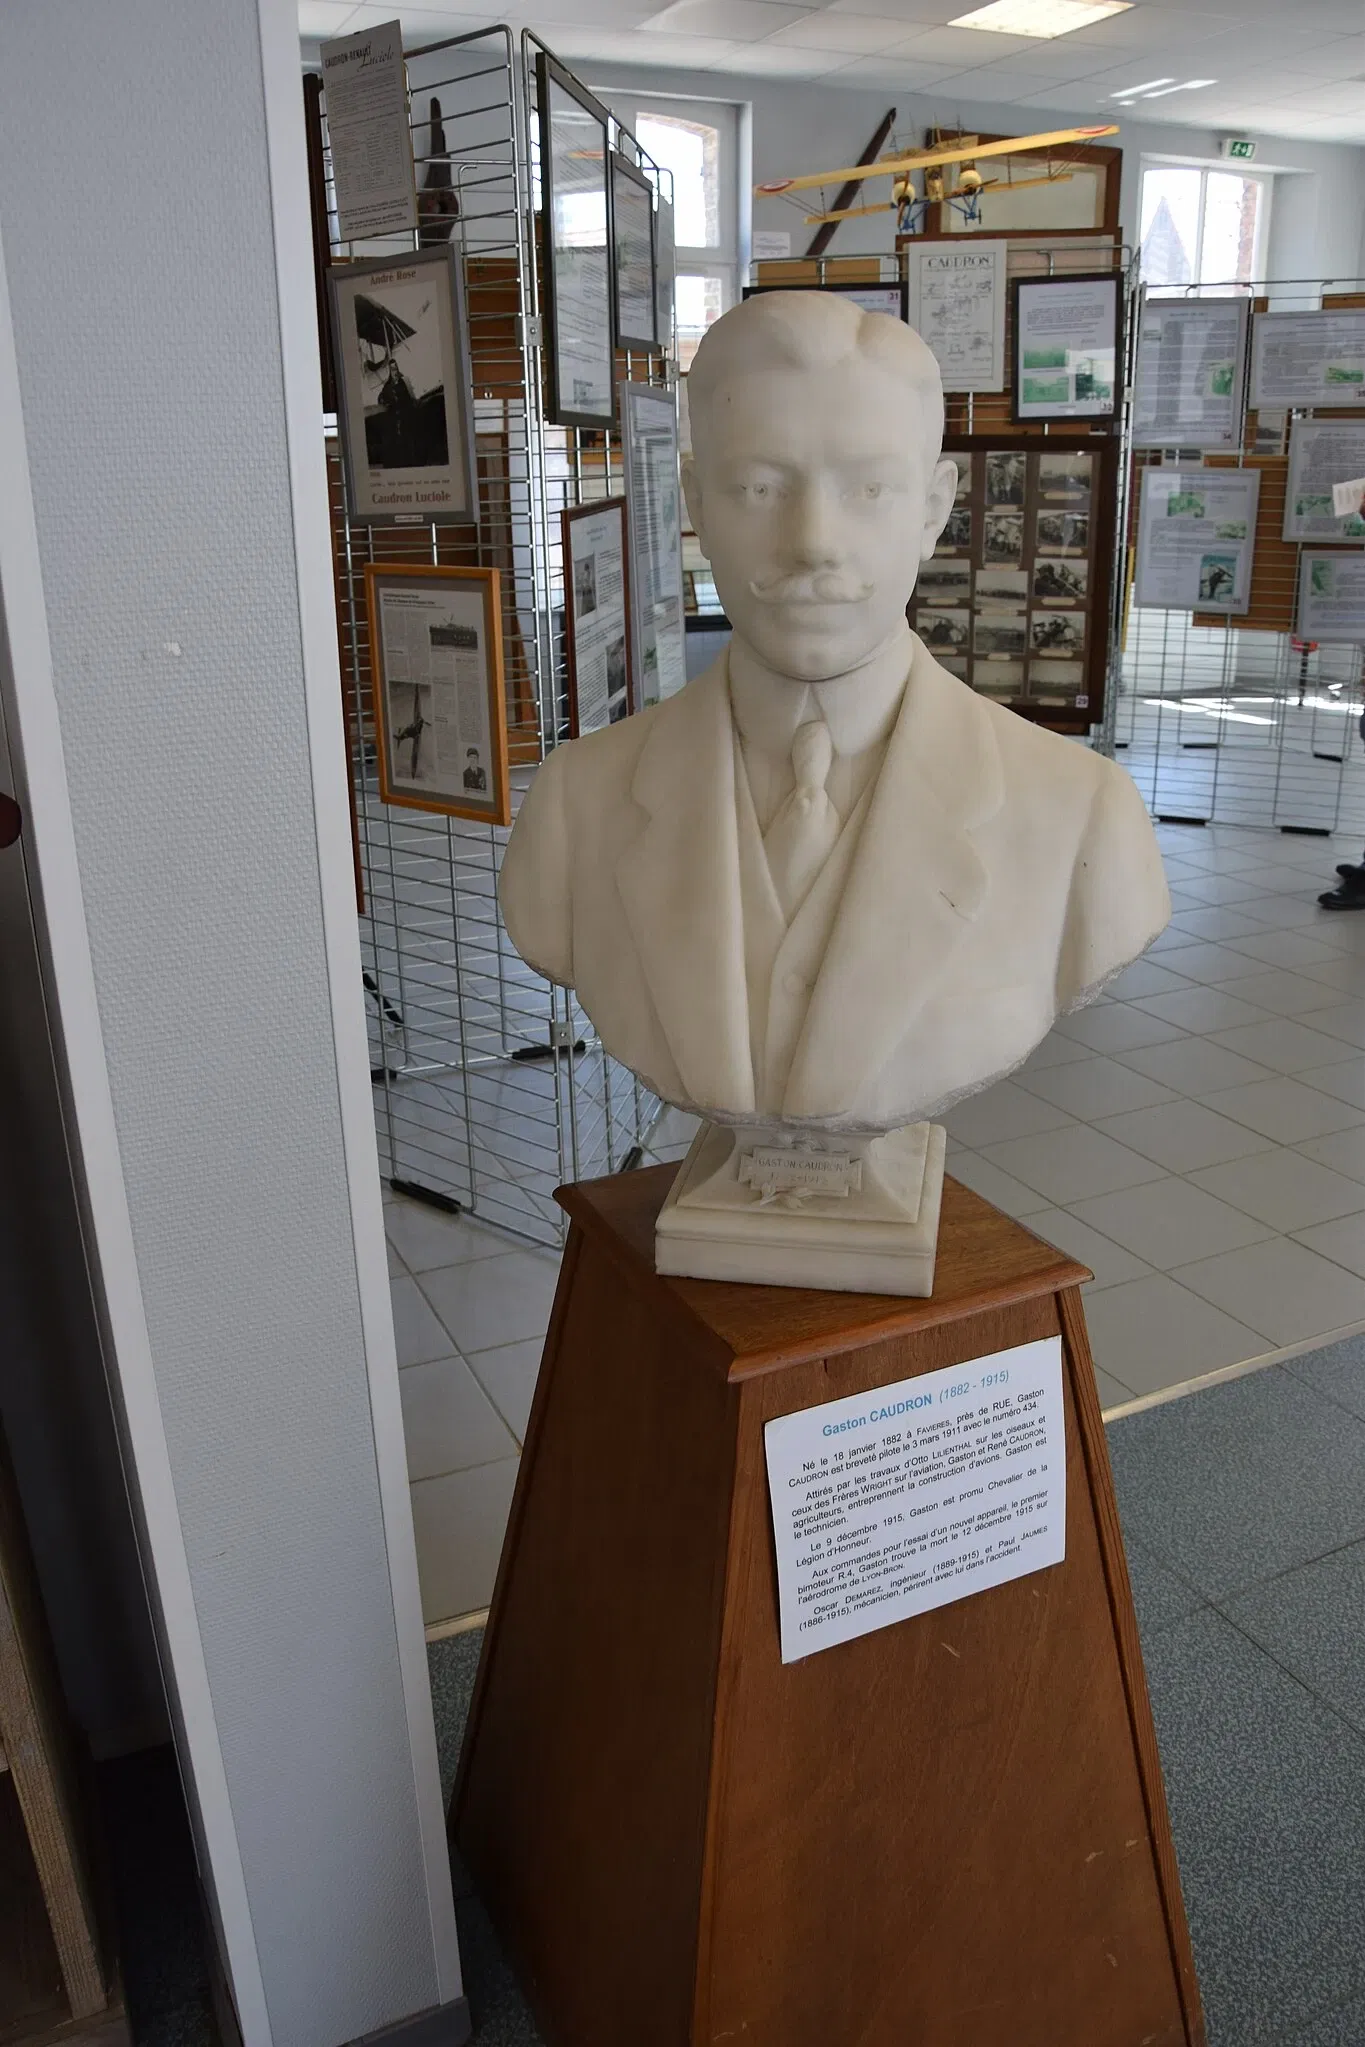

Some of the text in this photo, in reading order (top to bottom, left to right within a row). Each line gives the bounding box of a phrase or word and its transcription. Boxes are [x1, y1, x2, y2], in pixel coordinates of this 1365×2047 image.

[370, 269, 417, 286] André Rose
[928, 256, 990, 269] CAUDRON
[371, 490, 451, 505] Caudron Luciole
[802, 1460, 816, 1472] Né
[820, 1457, 829, 1467] le
[833, 1451, 845, 1462] 18
[848, 1442, 877, 1460] janvier
[881, 1433, 902, 1447] 1882
[906, 1430, 913, 1439] à
[956, 1411, 975, 1425] près
[977, 1406, 989, 1417] de
[1017, 1388, 1045, 1403] Gaston
[822, 1416, 867, 1437] Gaston
[869, 1393, 932, 1423] CAUDRON
[939, 1381, 970, 1404] (1882
[980, 1370, 1009, 1388] 1915)
[788, 1469, 829, 1488] CAUDRON
[830, 1463, 844, 1475] est
[845, 1452, 877, 1471] breveté
[878, 1446, 901, 1462] pilote
[902, 1443, 911, 1452] le
[919, 1434, 940, 1447] mars
[942, 1425, 961, 1439] 1911
[963, 1420, 982, 1433] avec
[983, 1417, 991, 1426] le
[992, 1407, 1022, 1423] numéro
[1022, 1401, 1040, 1412] 434.
[791, 1504, 813, 1517] ceux
[814, 1499, 830, 1510] des
[832, 1489, 859, 1504] Frères
[860, 1477, 892, 1495] WRIGHT
[894, 1473, 907, 1484] sur
[909, 1461, 946, 1479] l'aviation,
[947, 1450, 976, 1465] Gaston
[977, 1446, 986, 1456] et
[987, 1439, 1008, 1452] René
[793, 1436, 1047, 1529] agriculteurs, entreprennent la construction d'avions. Gaston est
[805, 1415, 1046, 1502] Attirés par les travaux d'Otto LILIENTHAL sur les oiseaux et
[793, 1516, 849, 1540] le technicien.
[810, 1542, 822, 1552] Le
[826, 1537, 833, 1547] 9
[836, 1523, 878, 1544] décembre
[909, 1502, 939, 1518] Gaston
[942, 1495, 955, 1507] est
[959, 1487, 984, 1503] promu
[987, 1472, 1023, 1491] Chevalier
[1026, 1468, 1037, 1477] de
[1041, 1464, 1048, 1472] la
[812, 1568, 829, 1579] Aux
[830, 1550, 881, 1573] commandes
[883, 1542, 902, 1556] pour
[903, 1533, 929, 1547] l'essai
[930, 1526, 948, 1538] d'un
[949, 1515, 975, 1531] nouvel
[1011, 1501, 1019, 1509] le
[1020, 1490, 1048, 1507] premier
[796, 1536, 872, 1568] Légion d'Honneur.
[797, 1500, 1048, 1595] bimoteur R.4, Gaston trouve la mort le 12 décembre 1915 sur
[813, 1525, 1048, 1616] Oscar DEMAREZ, ingénieur (1889-1915) et Paul JAUMES
[853, 1589, 901, 1611] mécanicien,
[903, 1576, 933, 1595] périrent
[934, 1570, 954, 1582] avec
[955, 1564, 964, 1575] lui
[965, 1558, 985, 1571] dans
[798, 1582, 848, 1605] l'aérodrome
[849, 1578, 860, 1587] de
